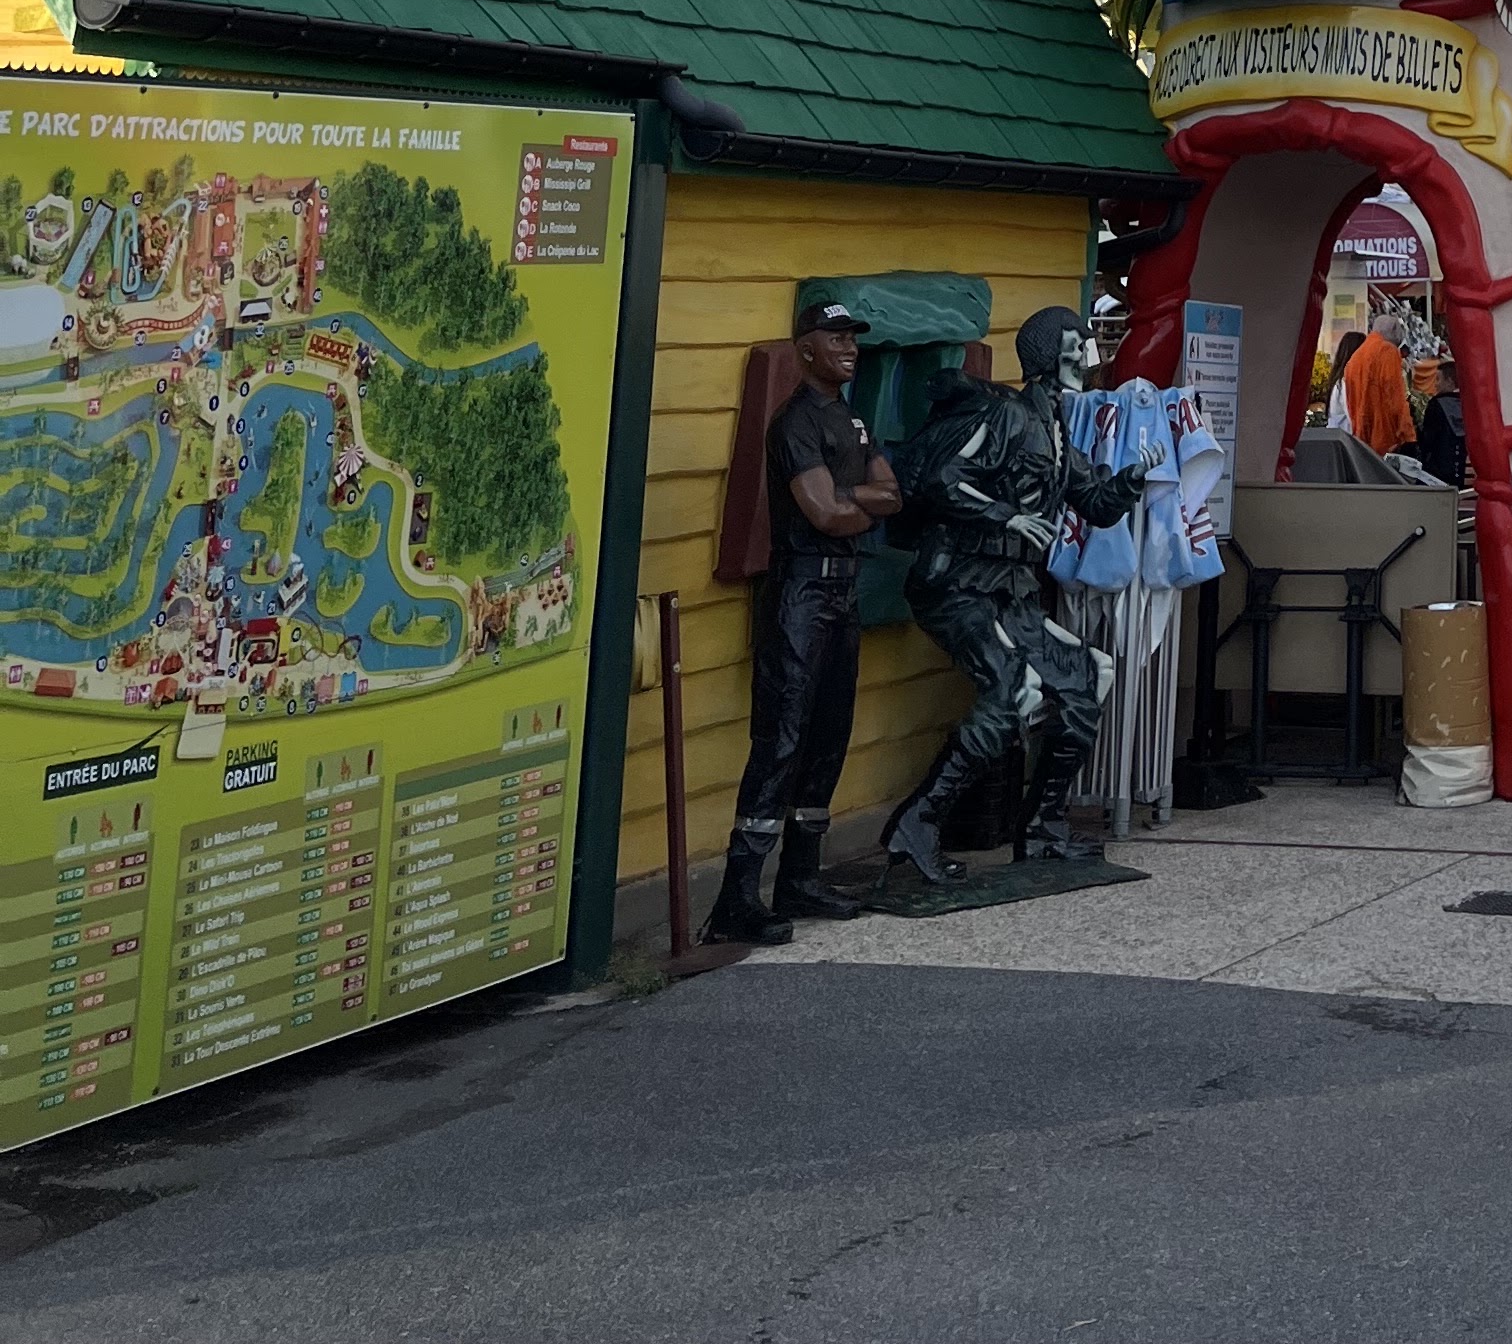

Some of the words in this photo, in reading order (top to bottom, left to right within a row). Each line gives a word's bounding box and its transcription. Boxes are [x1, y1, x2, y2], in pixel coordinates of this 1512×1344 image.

[1215, 28, 1242, 78] AUX
[1243, 22, 1320, 74] VISITEURS
[1320, 25, 1369, 76] MUNIS
[1371, 31, 1395, 82] DE
[1396, 33, 1464, 93] BILLETS
[21, 111, 81, 137] PARC
[90, 114, 246, 143] D'ATTRACTIONS
[252, 121, 304, 144] POUR
[311, 124, 366, 147] TOUTE
[371, 127, 391, 148] LA
[398, 128, 462, 150] FAMILLE
[226, 740, 278, 766] PARKING
[47, 763, 98, 791] ENTRÉE
[101, 764, 120, 780] DU
[123, 754, 156, 777] PARC
[224, 761, 277, 791] GRATUIT
